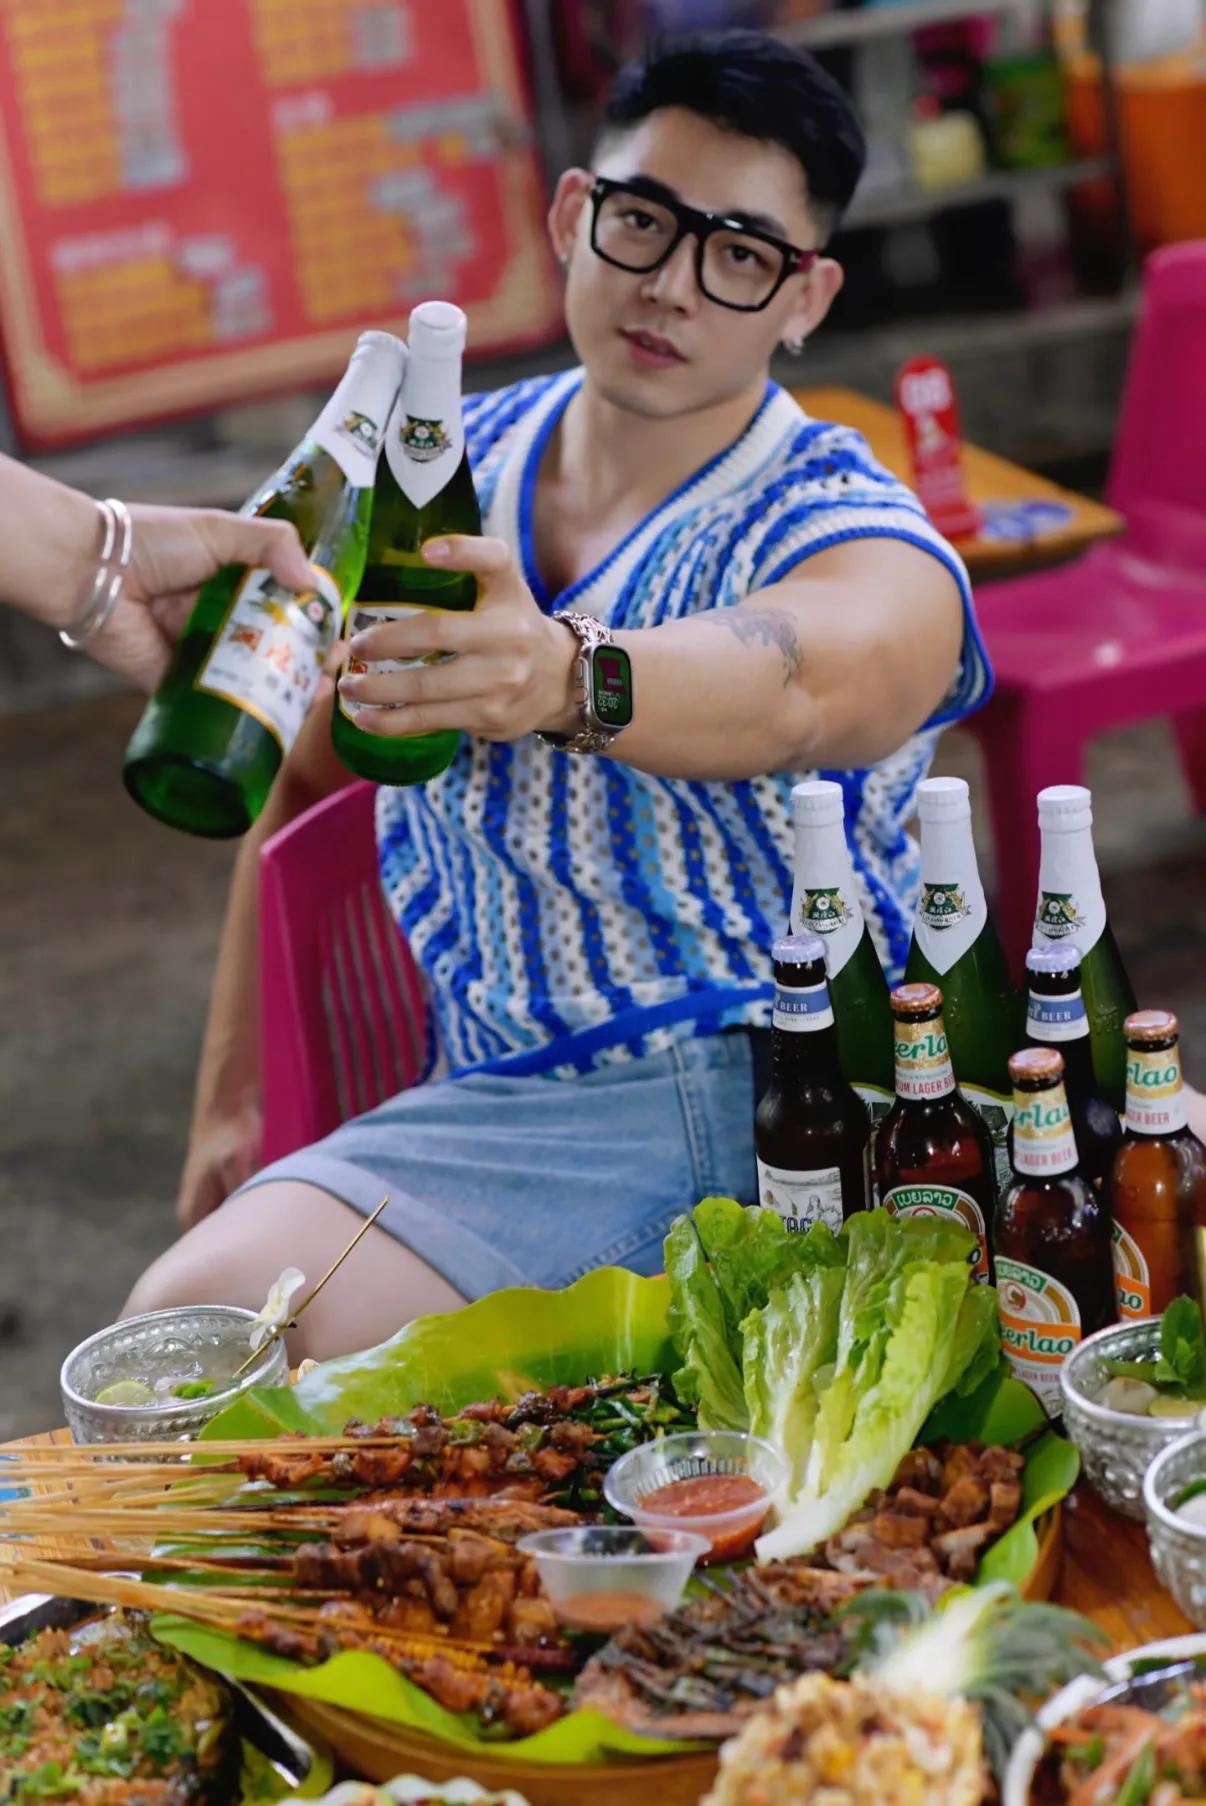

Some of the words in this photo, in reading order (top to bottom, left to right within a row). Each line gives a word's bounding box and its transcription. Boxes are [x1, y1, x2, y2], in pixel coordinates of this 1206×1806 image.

[780, 1001, 808, 1012] BEER
[1041, 1010, 1071, 1021] BEER
[913, 1079, 942, 1095] LAGER
